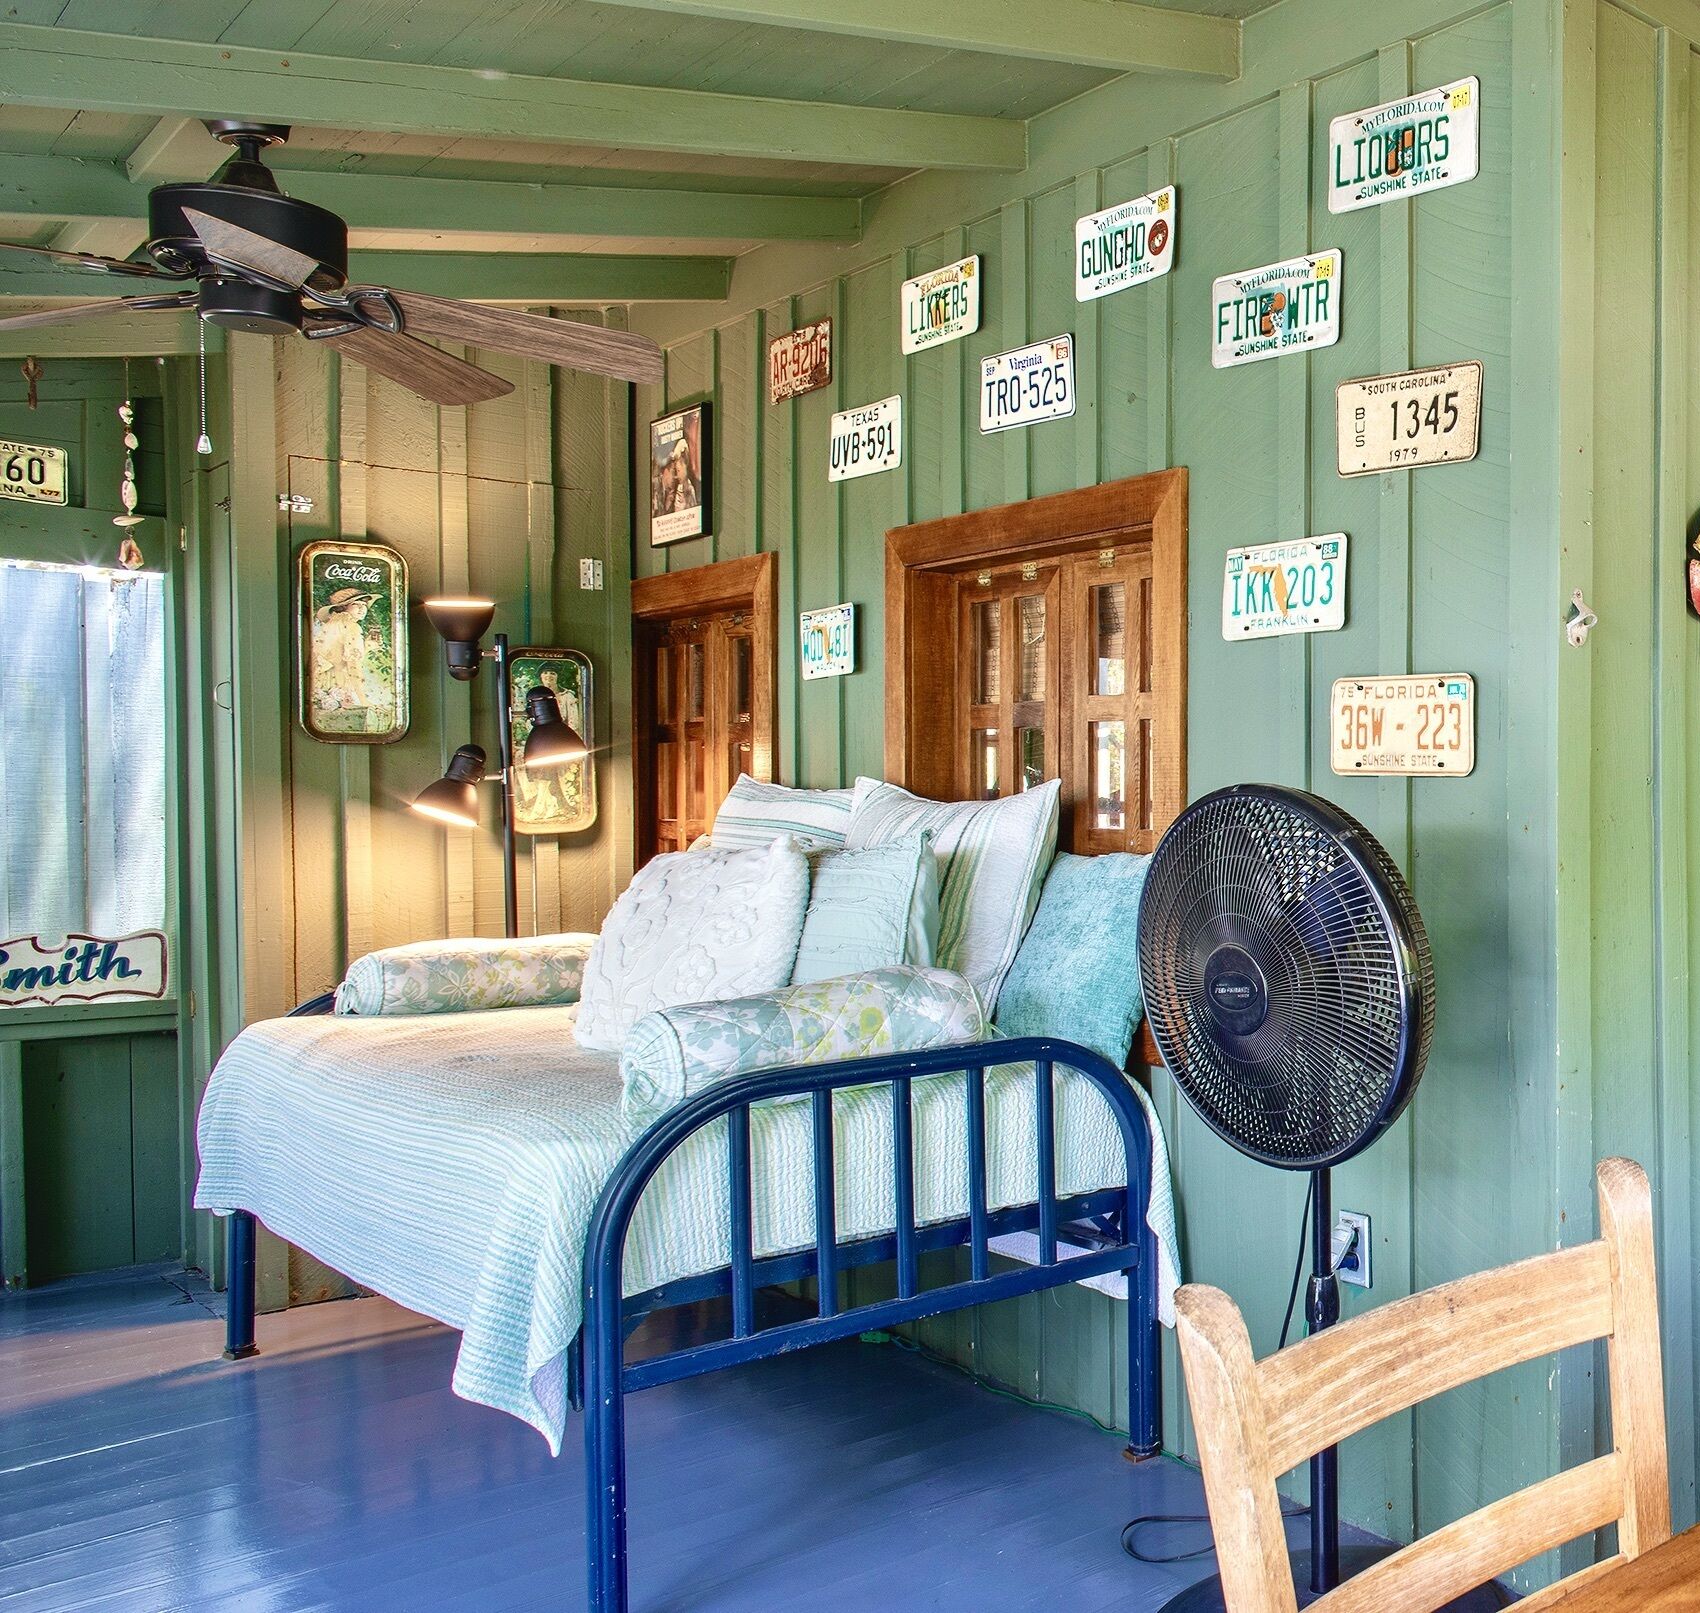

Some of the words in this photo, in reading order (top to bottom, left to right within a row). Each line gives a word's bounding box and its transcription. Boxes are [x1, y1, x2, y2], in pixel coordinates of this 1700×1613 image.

[1335, 115, 1450, 188] LIQUORS
[1360, 176, 1407, 199] SUNSHINE
[1412, 166, 1442, 186] STATE
[1081, 222, 1146, 279] GUNGHO
[1098, 269, 1128, 289] SUNSHINE
[1130, 262, 1151, 278] STATE
[910, 281, 968, 335] LIKKERS
[1218, 292, 1275, 345] FIRE
[1287, 279, 1330, 331] WTR
[944, 321, 960, 335] STATE
[1057, 347, 1068, 359] 96
[1239, 336, 1278, 356] SUNSHINE
[1282, 331, 1308, 347] STATE
[1009, 353, 1043, 371] Virginia
[986, 363, 1067, 418] TRO-525
[1367, 381, 1397, 396] SOUTH
[1399, 374, 1447, 391] CAROLINA
[851, 408, 879, 427] TEXAS
[1355, 407, 1366, 448] BUS
[1391, 391, 1459, 441] 1345
[0, 443, 24, 453] ATE
[38, 449, 55, 458] 75
[1389, 447, 1418, 462] 1979
[0, 484, 27, 495] NA
[1253, 545, 1308, 563] FLORIDA
[1232, 569, 1275, 616] IKK
[1286, 562, 1334, 610] 203
[1250, 615, 1308, 629] FRANKLIN
[1363, 684, 1437, 700] FLORIDA
[1341, 705, 1385, 750] 36W
[1416, 703, 1461, 750] 223
[1362, 754, 1405, 767] SUNSHINE
[1411, 754, 1437, 767] STATE
